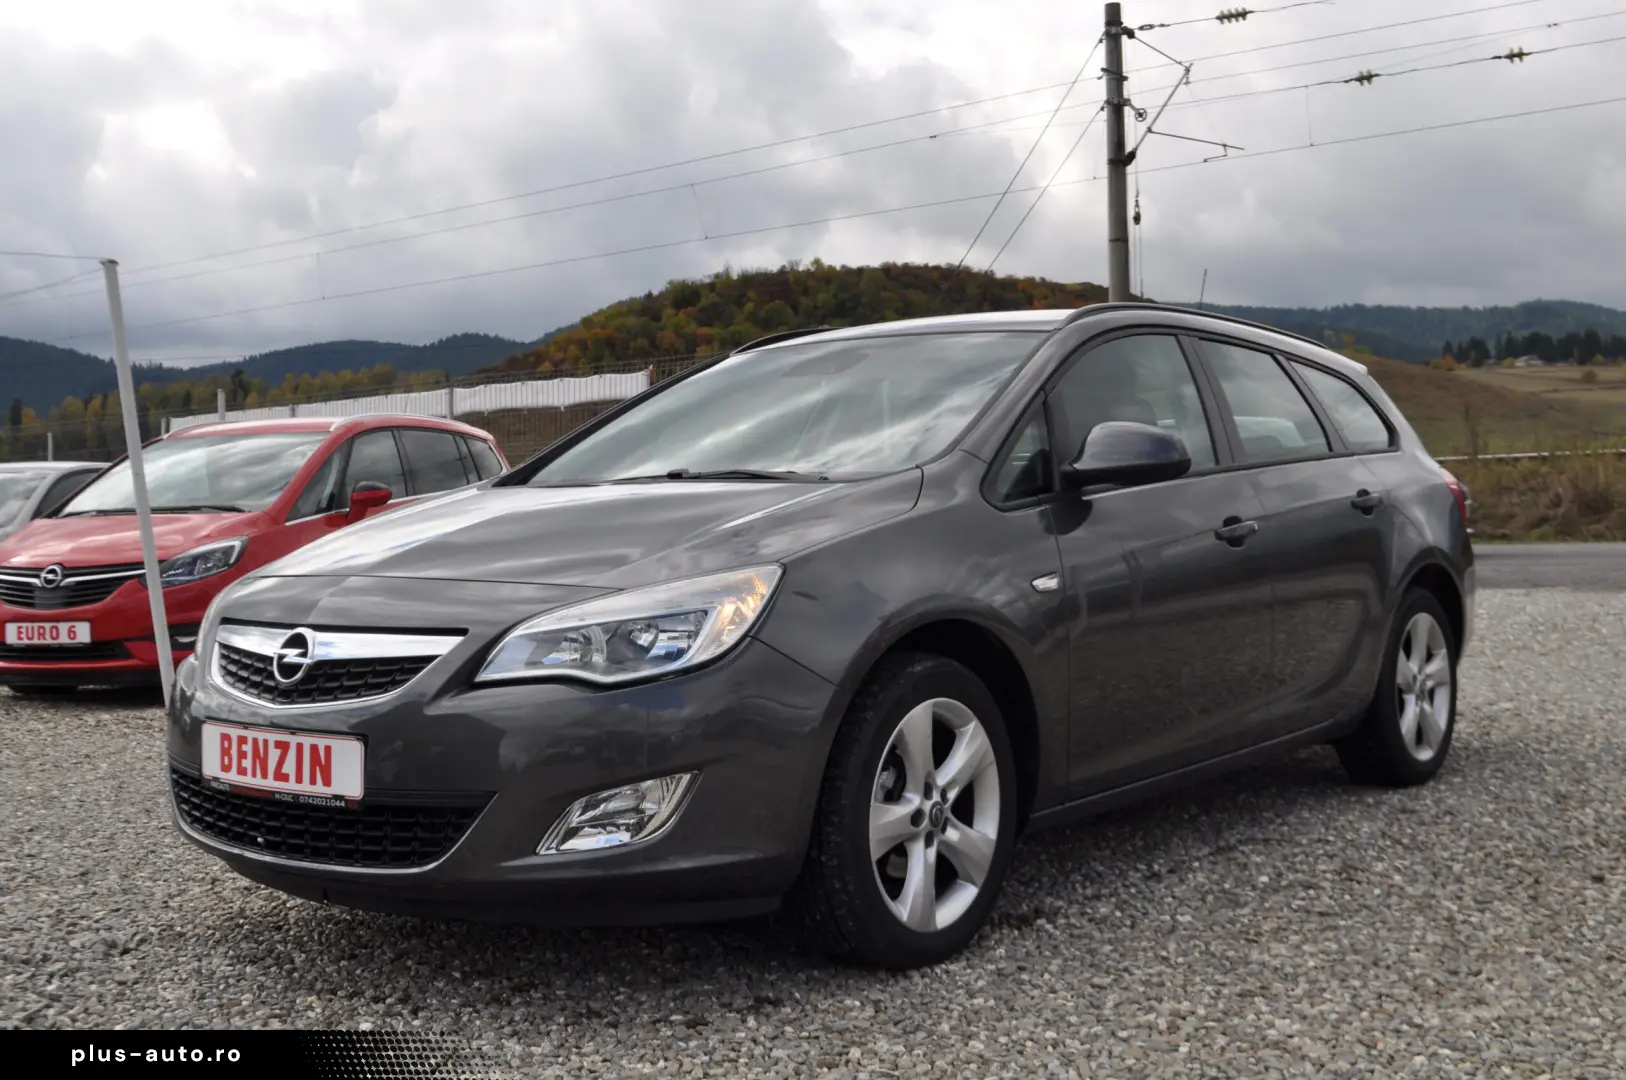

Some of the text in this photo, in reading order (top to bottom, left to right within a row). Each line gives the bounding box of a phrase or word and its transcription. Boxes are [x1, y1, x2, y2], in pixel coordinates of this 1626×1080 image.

[16, 624, 77, 641] EURO 6
[219, 732, 333, 788] BENZIN
[299, 796, 346, 807] 0742021044
